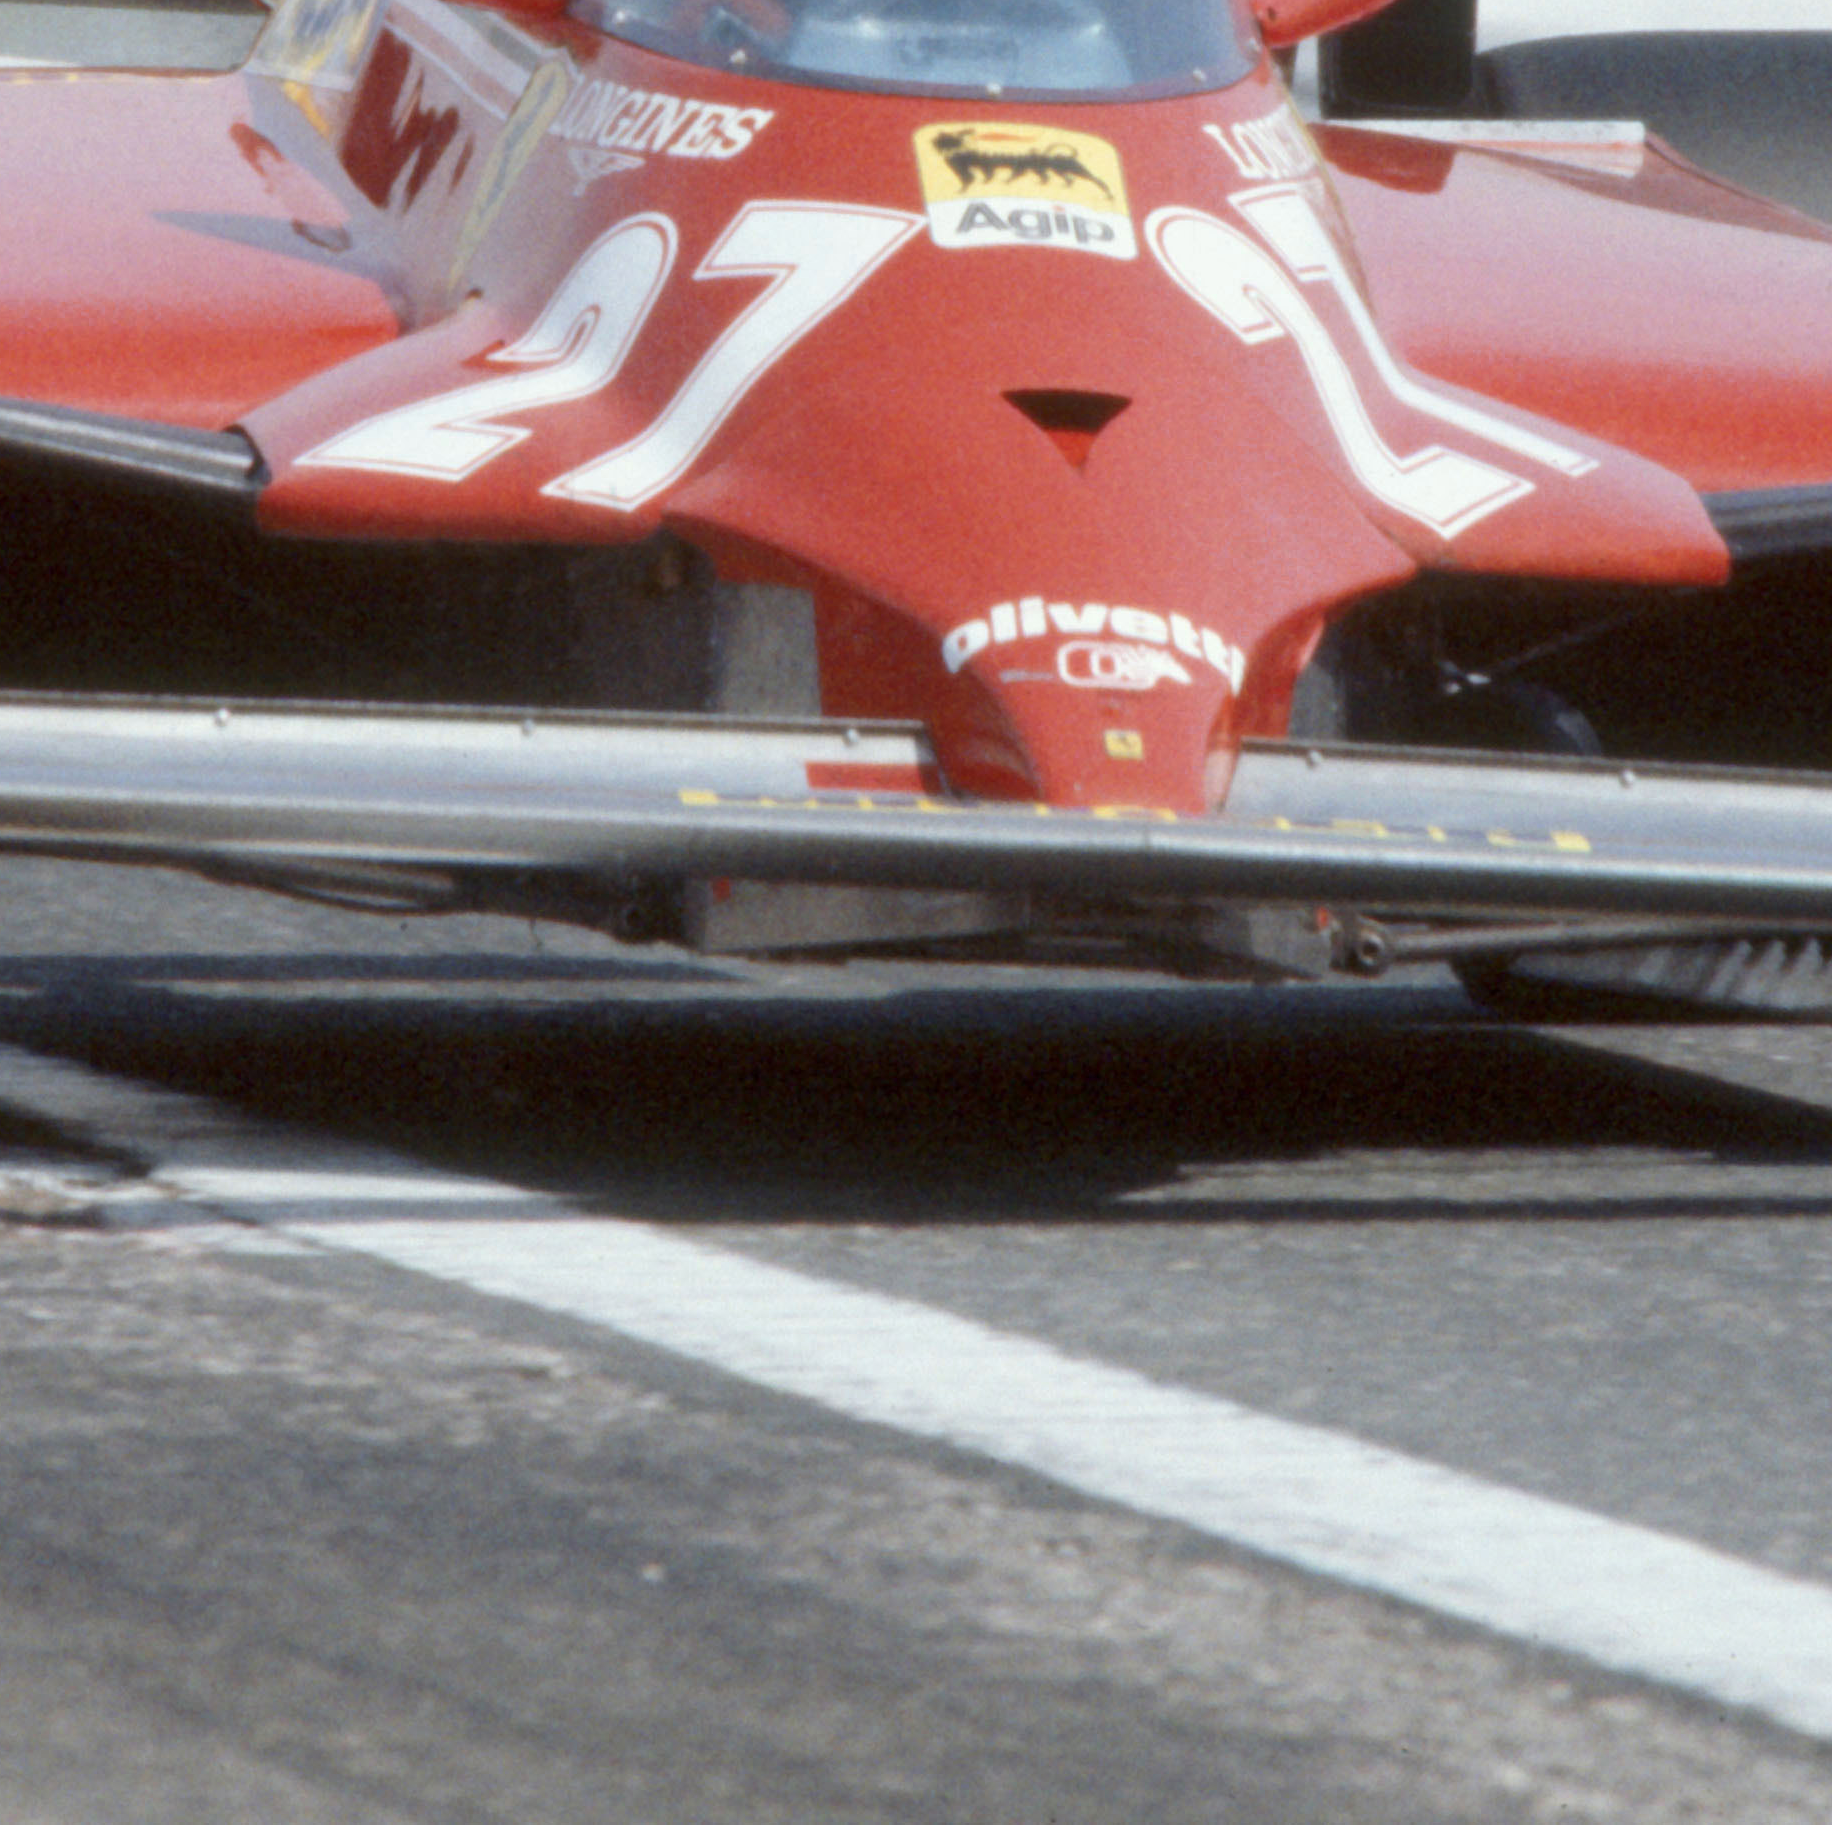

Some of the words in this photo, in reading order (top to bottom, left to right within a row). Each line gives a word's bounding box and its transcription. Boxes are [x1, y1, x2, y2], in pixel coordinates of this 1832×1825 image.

[547, 74, 775, 161] LONGINES
[956, 200, 1116, 245] Agip
[291, 198, 929, 514] 27
[942, 596, 1247, 700] olivetti
